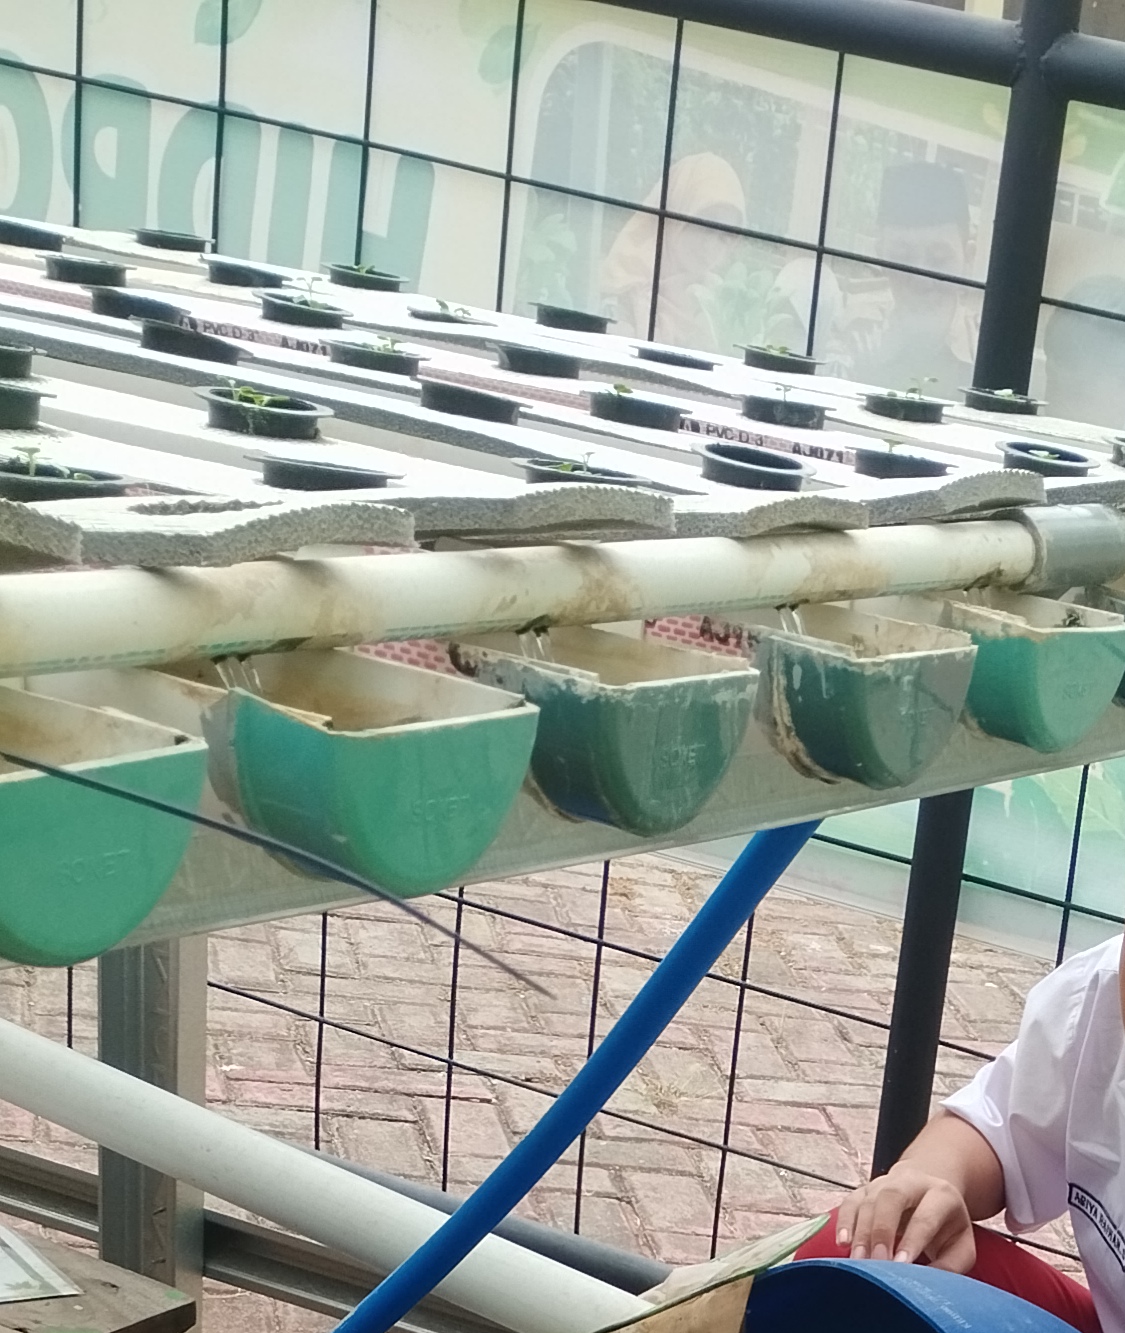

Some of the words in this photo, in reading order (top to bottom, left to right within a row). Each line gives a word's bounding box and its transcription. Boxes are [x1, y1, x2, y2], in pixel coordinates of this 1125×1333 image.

[203, 321, 228, 336] PVC
[706, 423, 733, 440] PVC
[739, 430, 750, 443] D
